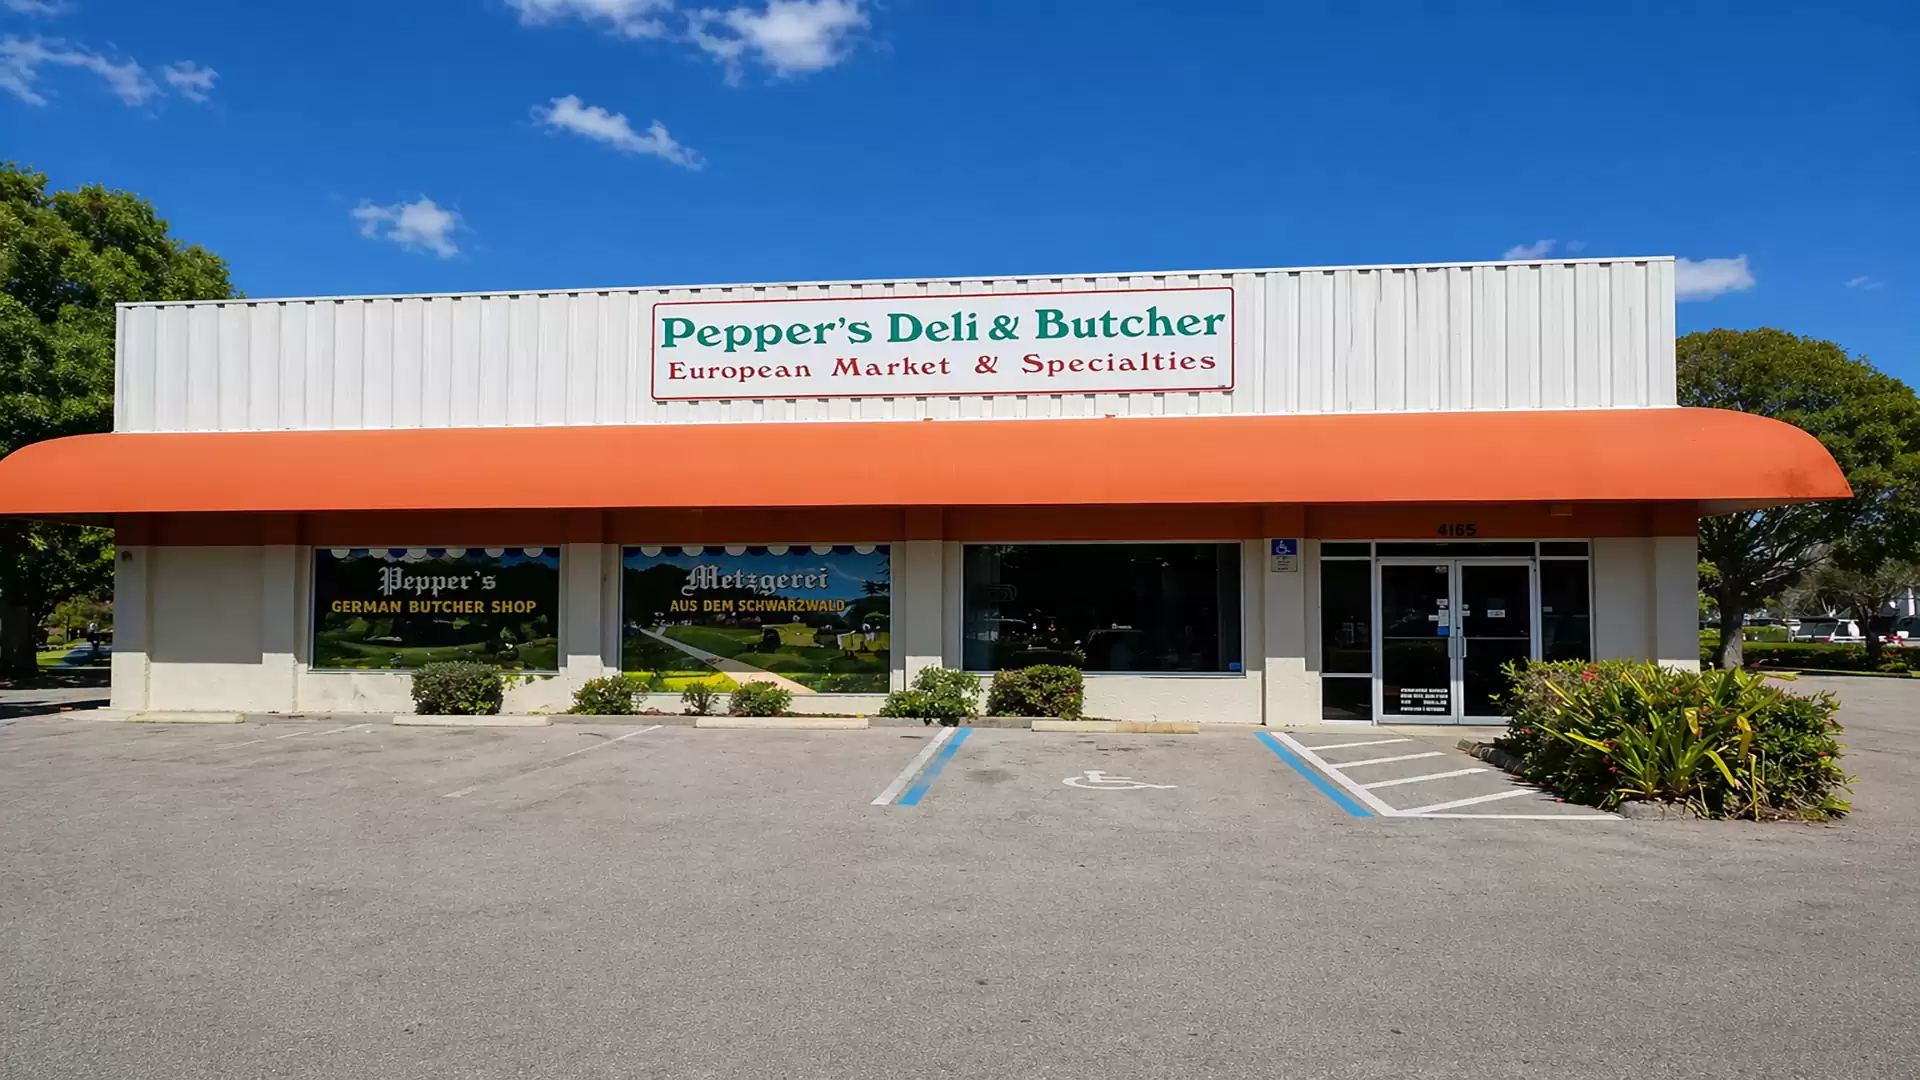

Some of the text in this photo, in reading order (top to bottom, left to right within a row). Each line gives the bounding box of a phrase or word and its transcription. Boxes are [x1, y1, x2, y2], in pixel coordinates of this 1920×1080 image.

[661, 306, 1225, 352] Pepper's Deli & Butcher
[668, 351, 1216, 383] European Market & Specialties
[1437, 523, 1477, 537] 4165
[377, 566, 496, 597] Pepper's
[681, 564, 828, 596] Metzgerei
[331, 600, 537, 613] GERMAN BUTCHER SHOP
[669, 599, 845, 612] AUS DEM SCHWARZWALD
